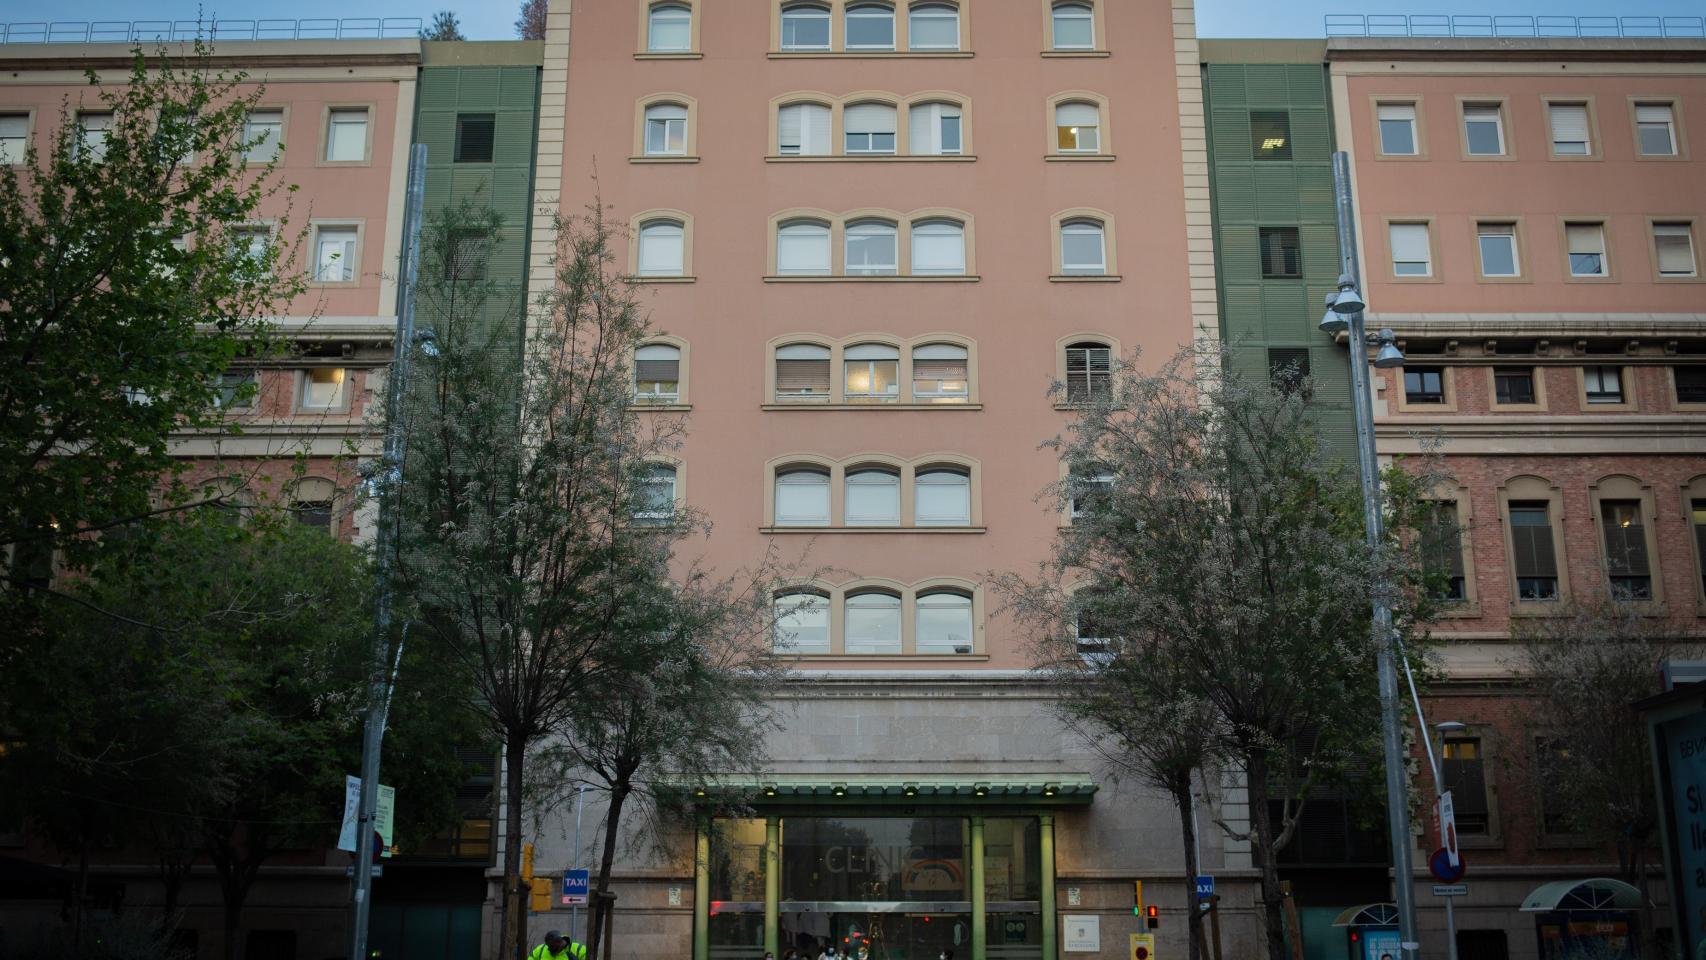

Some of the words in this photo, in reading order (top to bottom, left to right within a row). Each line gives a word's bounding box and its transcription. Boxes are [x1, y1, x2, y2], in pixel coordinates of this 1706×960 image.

[1687, 784, 1703, 814] Si
[565, 878, 587, 887] TAXI
[1696, 867, 1706, 889] a
[1197, 884, 1212, 893] AXI
